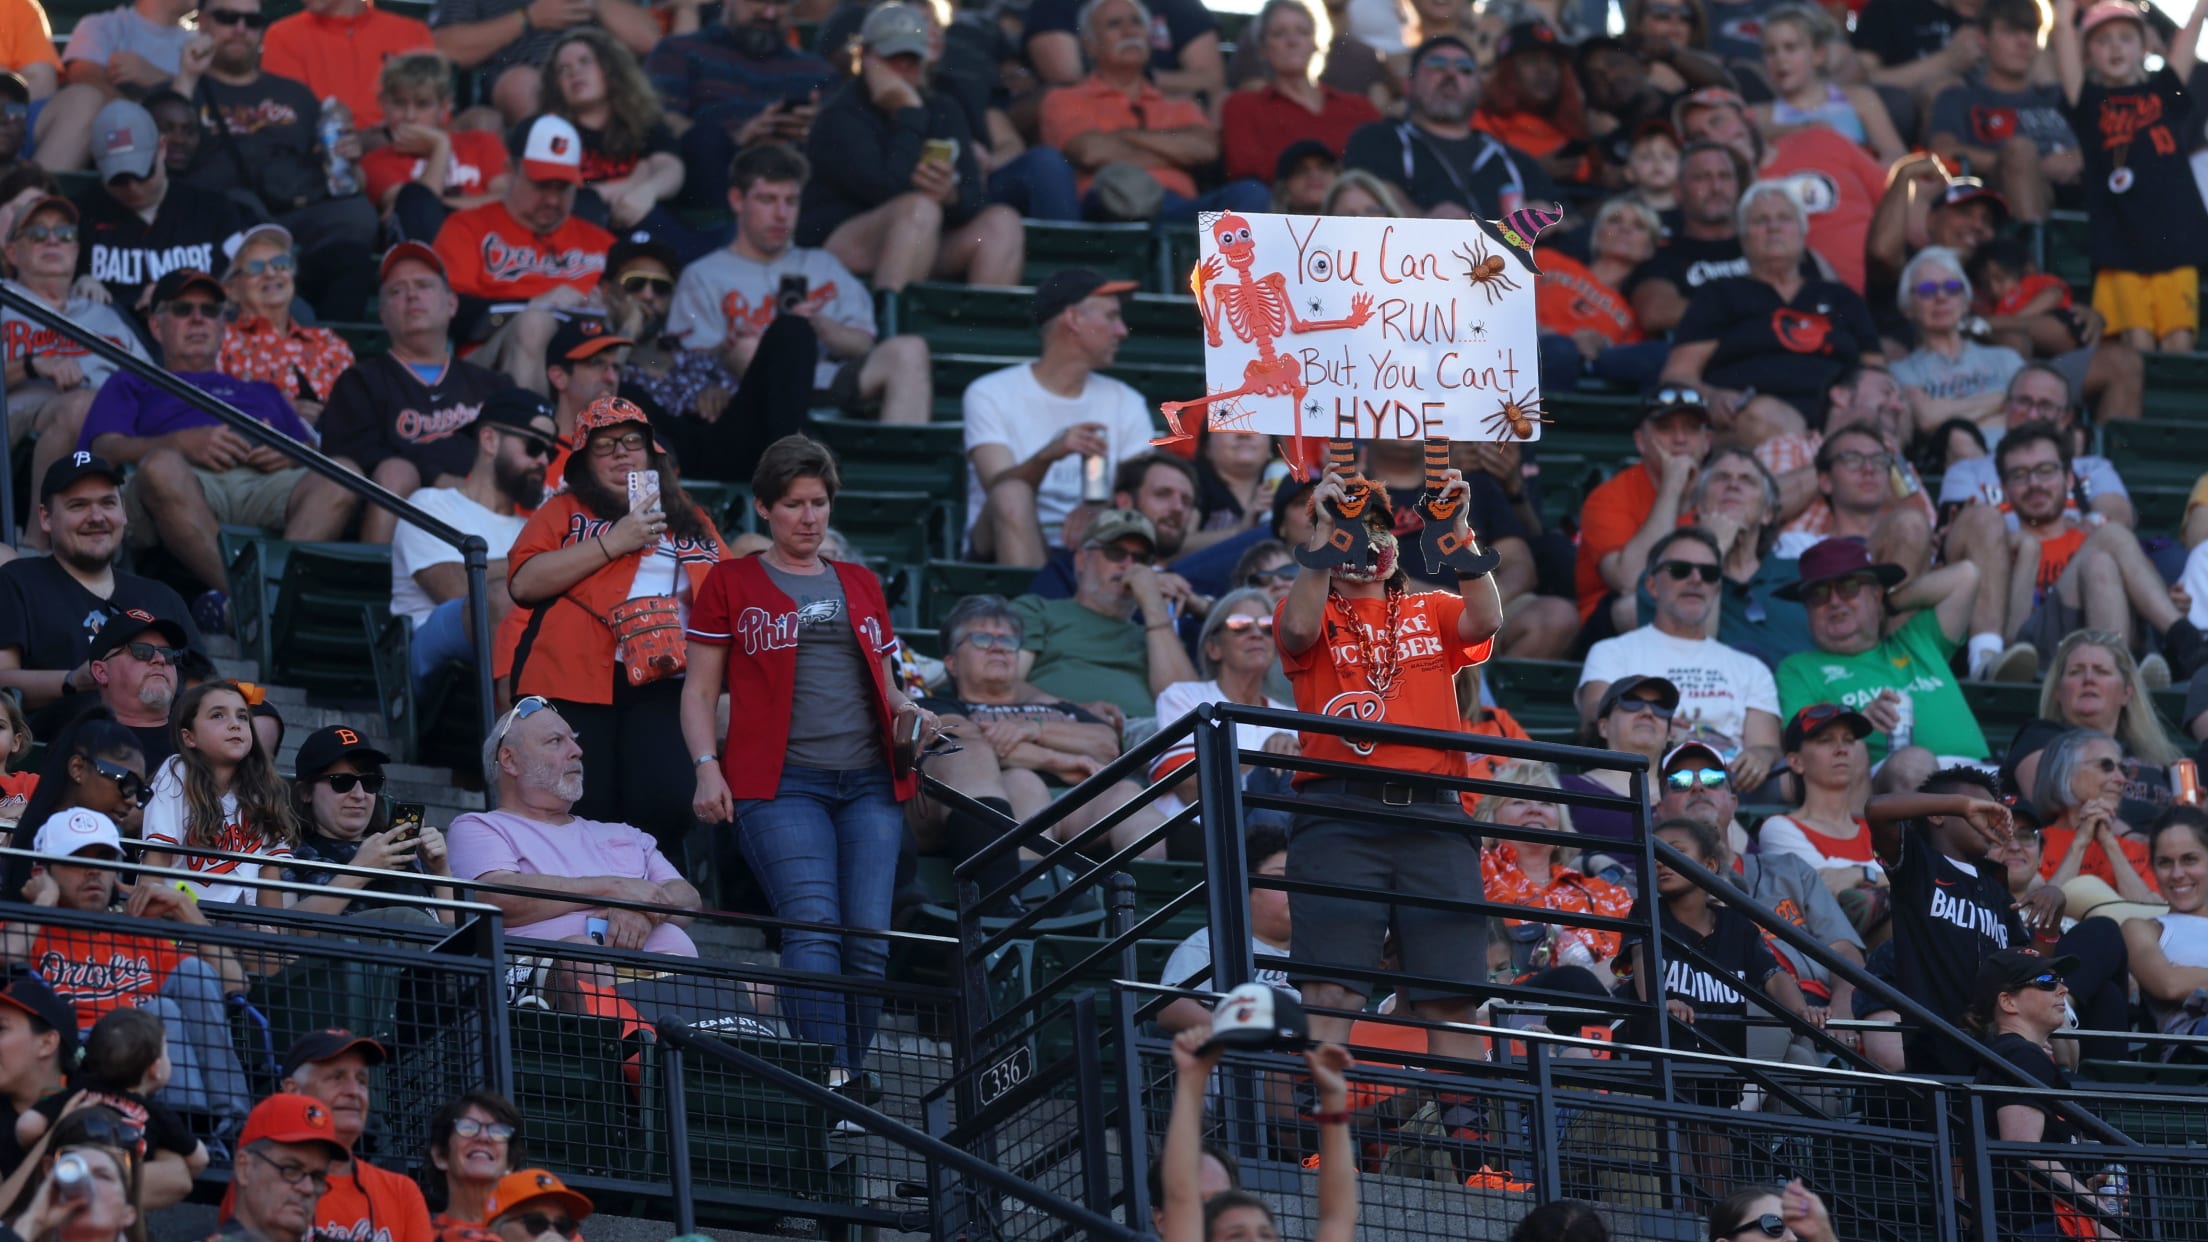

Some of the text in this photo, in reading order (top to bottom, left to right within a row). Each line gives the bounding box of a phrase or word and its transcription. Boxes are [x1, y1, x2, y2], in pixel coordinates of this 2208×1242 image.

[91, 243, 212, 283] BALTMORE
[1285, 217, 1450, 286] You Can
[1369, 349, 1424, 392] You
[1436, 348, 1520, 393] Can't
[1334, 396, 1450, 441] HYDE
[73, 451, 91, 467] B
[1330, 637, 1443, 665] OCOBER
[335, 729, 358, 745] B
[40, 950, 153, 1004] Orioles
[1662, 959, 1746, 1003] ALTIMO
[991, 1055, 1020, 1097] 336
